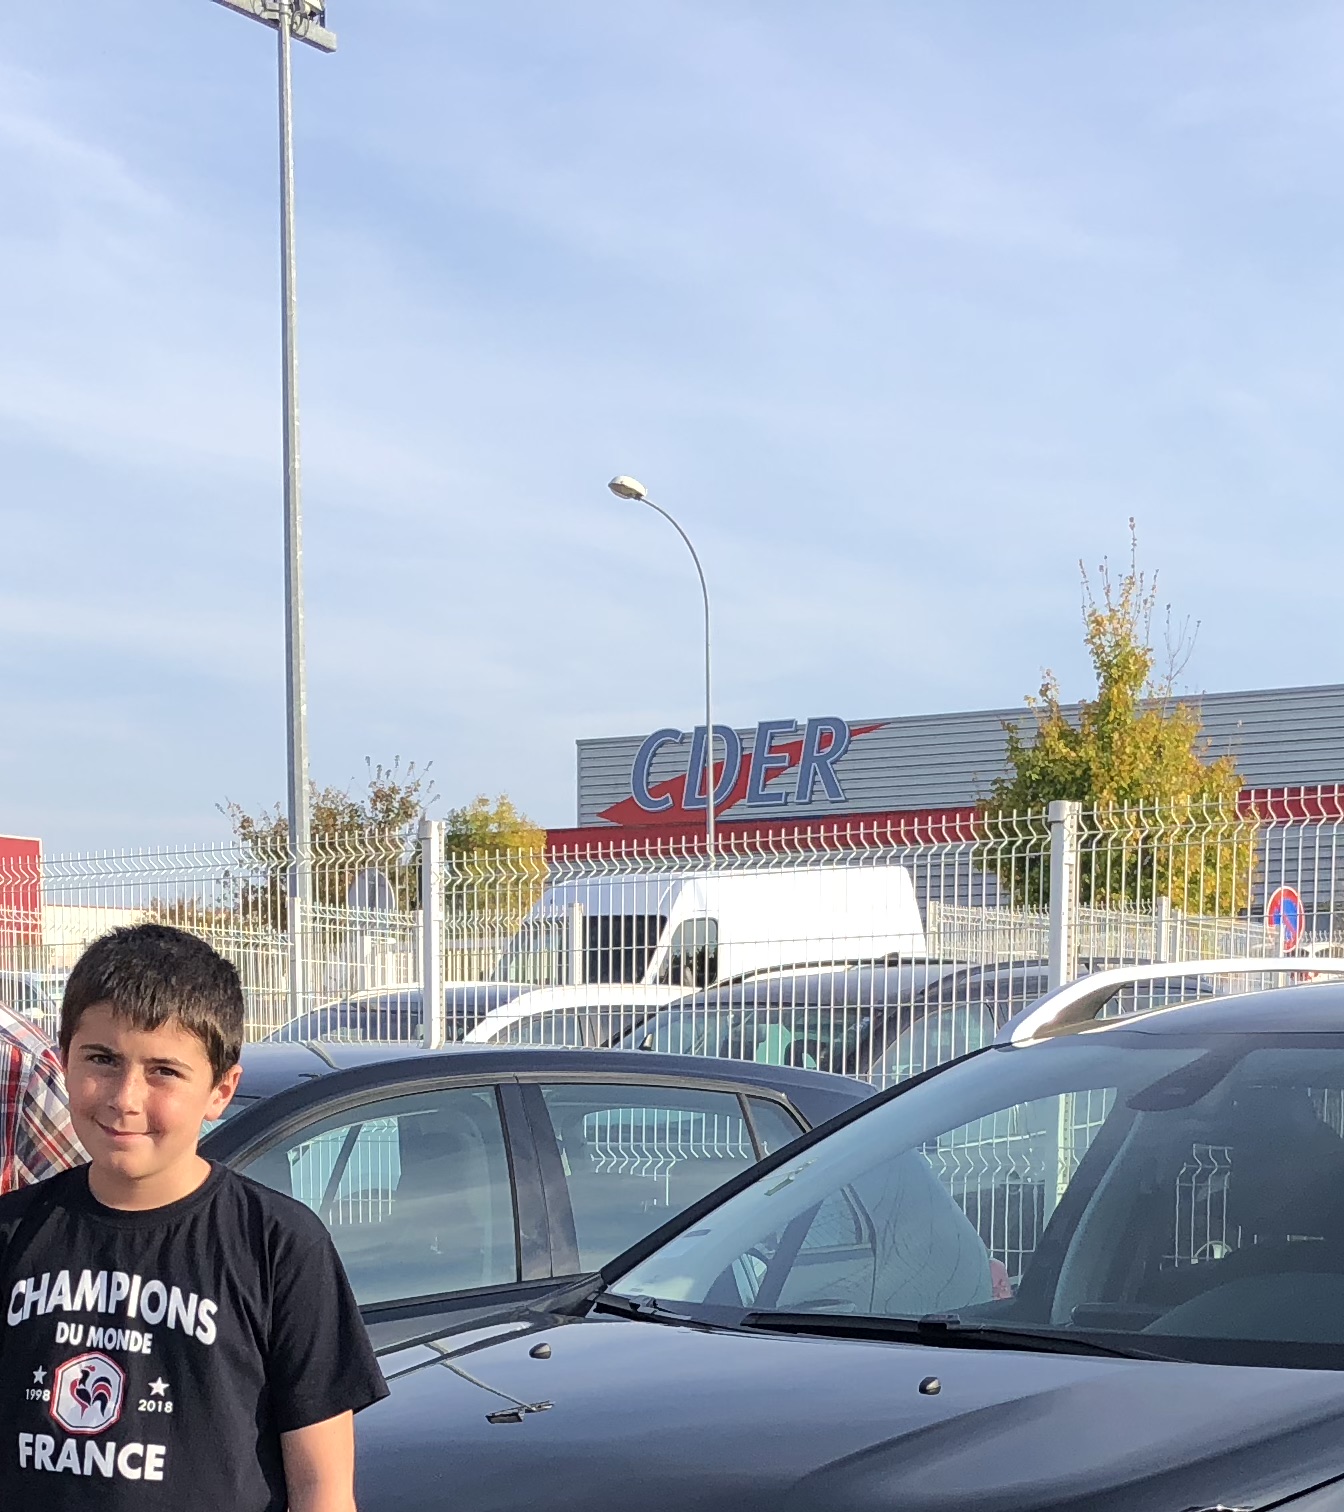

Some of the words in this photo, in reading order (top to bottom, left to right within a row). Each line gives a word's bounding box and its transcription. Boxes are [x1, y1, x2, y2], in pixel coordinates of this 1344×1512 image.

[630, 716, 851, 812] CDER
[7, 1269, 218, 1346] CHAMPIONS
[56, 1321, 84, 1346] DU
[86, 1324, 153, 1354] MONDE
[25, 1388, 51, 1402] 1998
[137, 1399, 174, 1414] 2018
[18, 1432, 167, 1481] FRANCE
